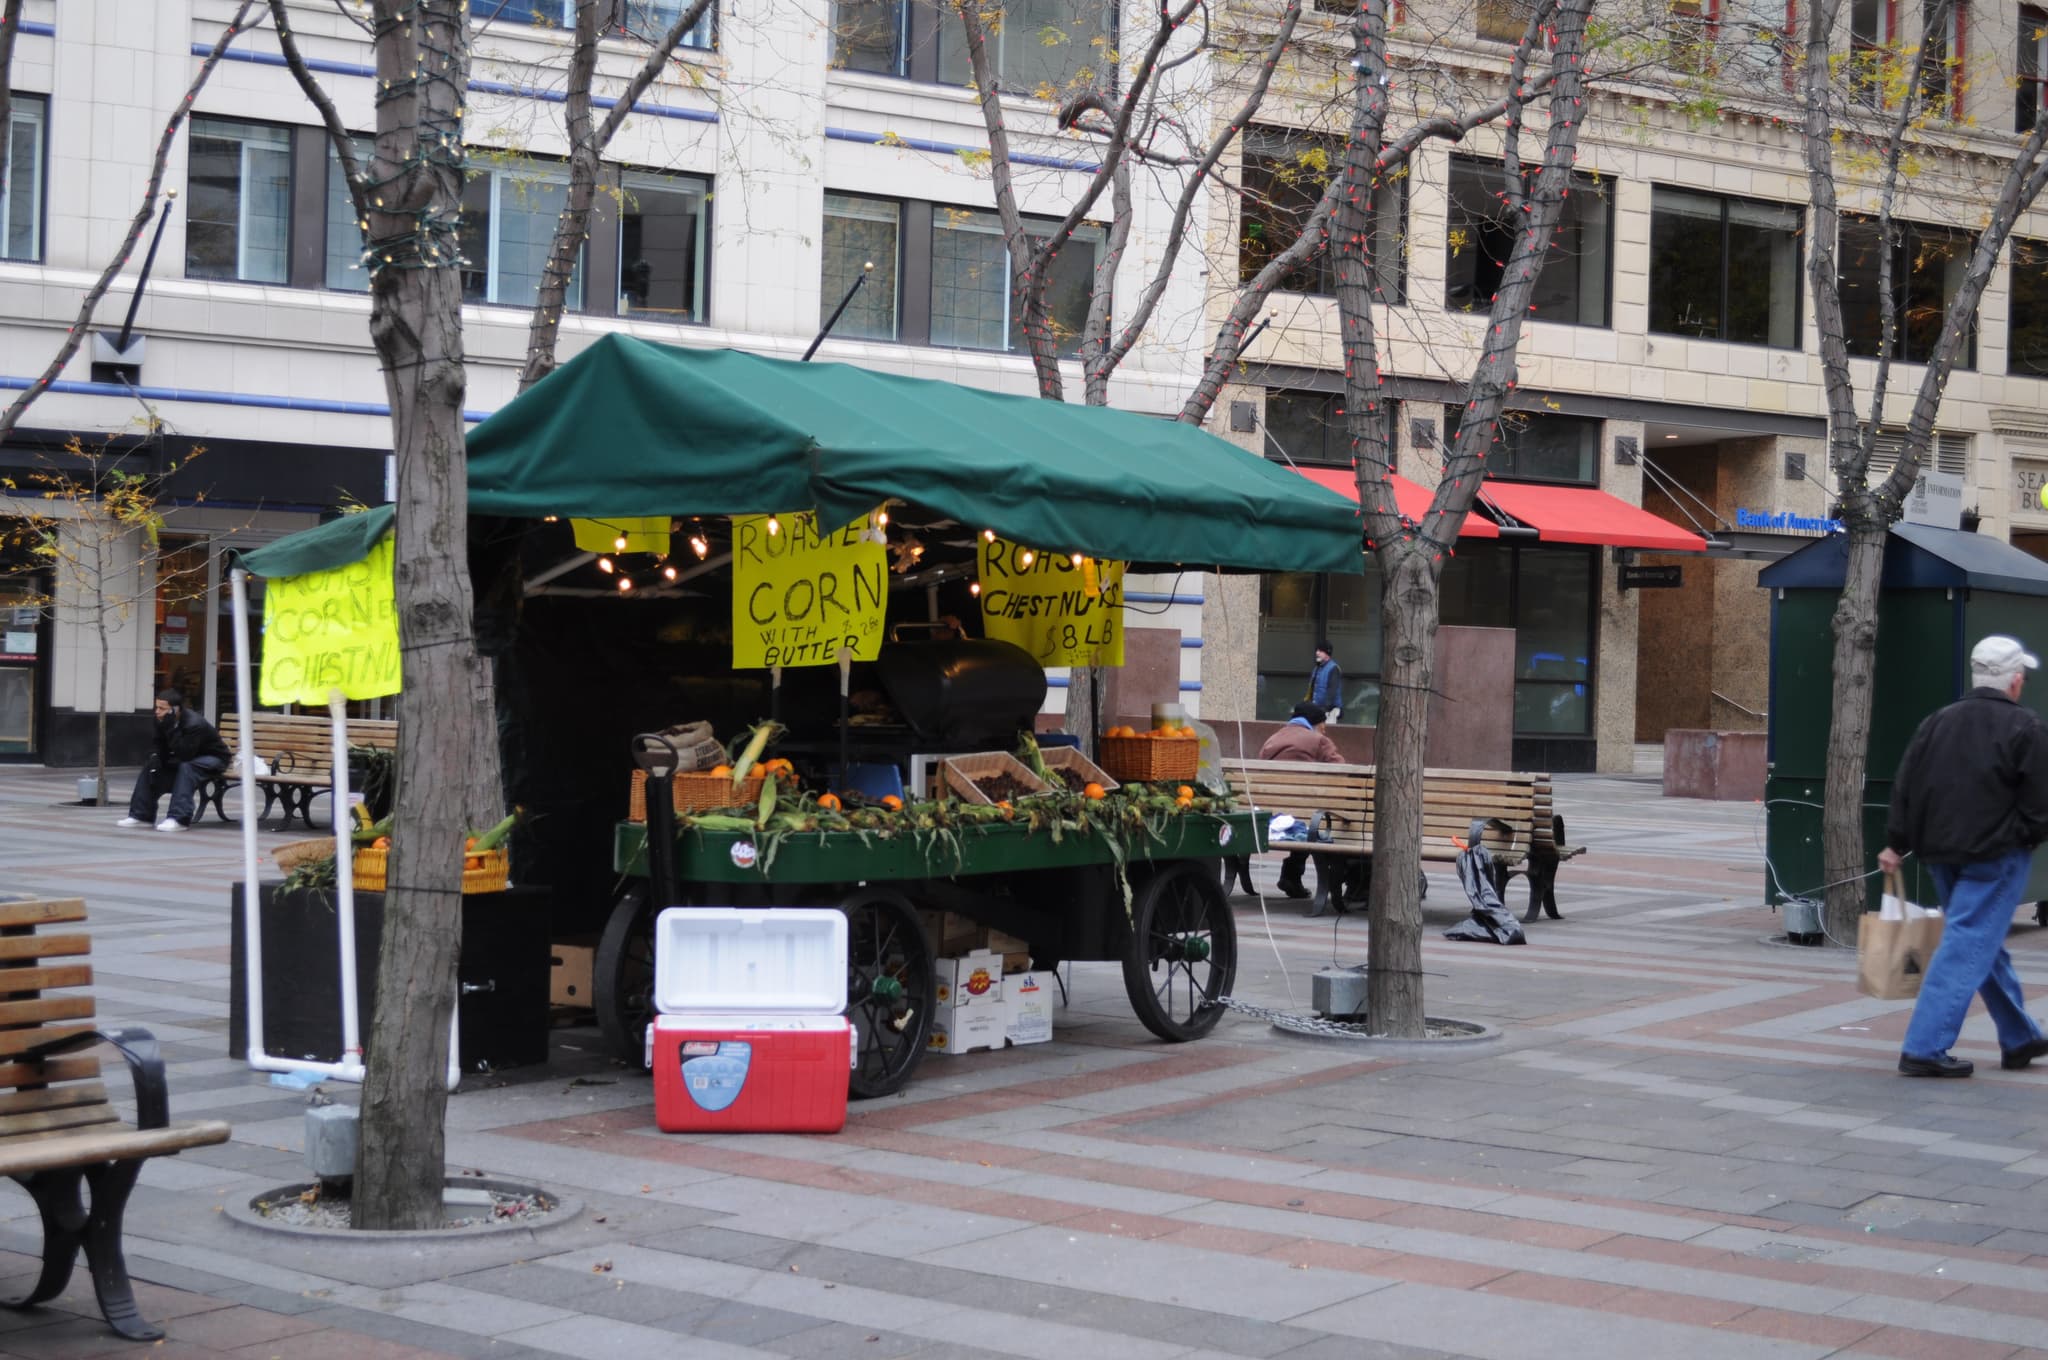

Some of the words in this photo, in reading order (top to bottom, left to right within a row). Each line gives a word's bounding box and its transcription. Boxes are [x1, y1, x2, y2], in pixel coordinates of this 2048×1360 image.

[1737, 508, 1768, 527] Bank
[1772, 511, 1786, 528] of
[749, 563, 881, 625] CORN
[760, 626, 818, 645] WITH
[764, 635, 862, 667] BUTTER
